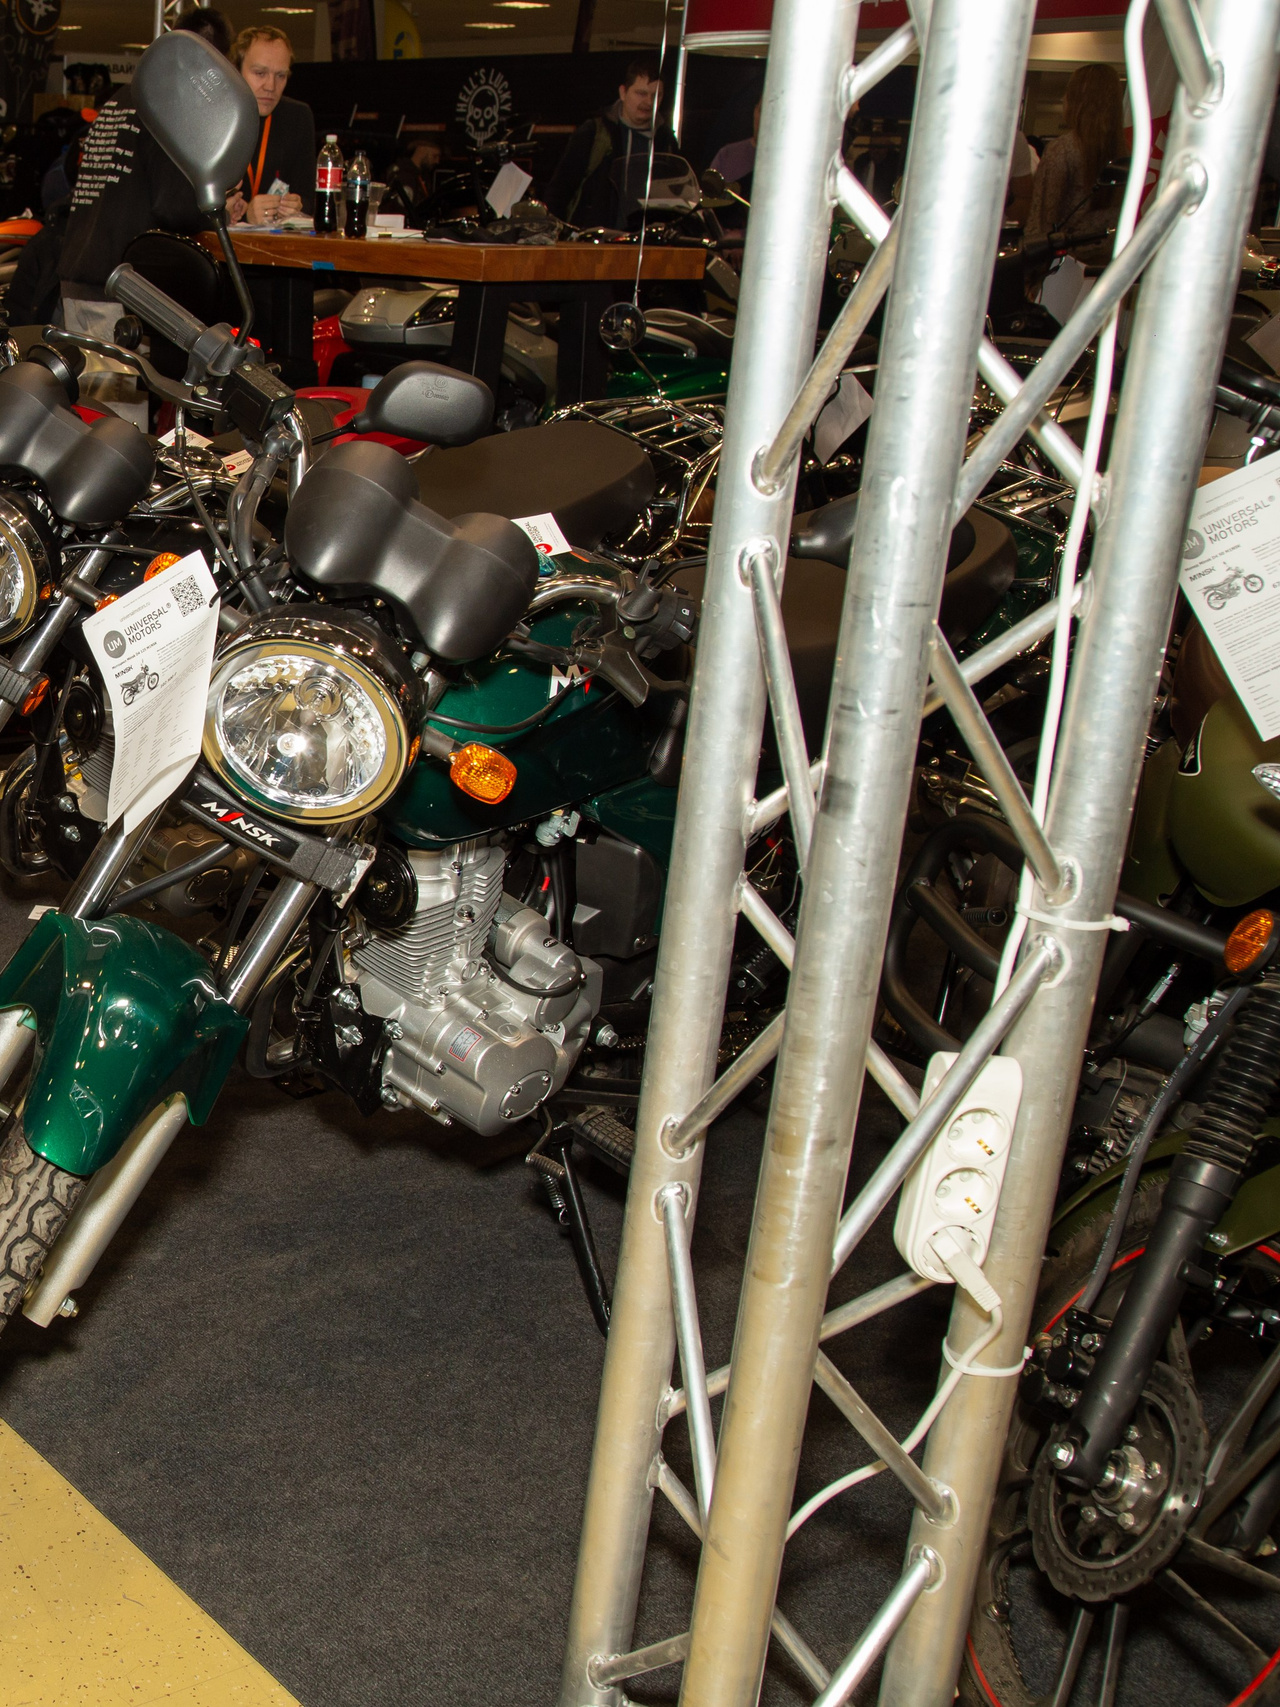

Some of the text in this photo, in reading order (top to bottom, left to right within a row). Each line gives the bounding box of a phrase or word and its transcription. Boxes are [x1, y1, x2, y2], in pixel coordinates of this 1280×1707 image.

[456, 68, 512, 113] HELL'S LUCKY
[1204, 499, 1270, 535] UNIVERSAL
[1208, 517, 1259, 545] MOTORS
[124, 607, 168, 636] UNIVERSAL
[107, 622, 162, 652] UM MOTORS
